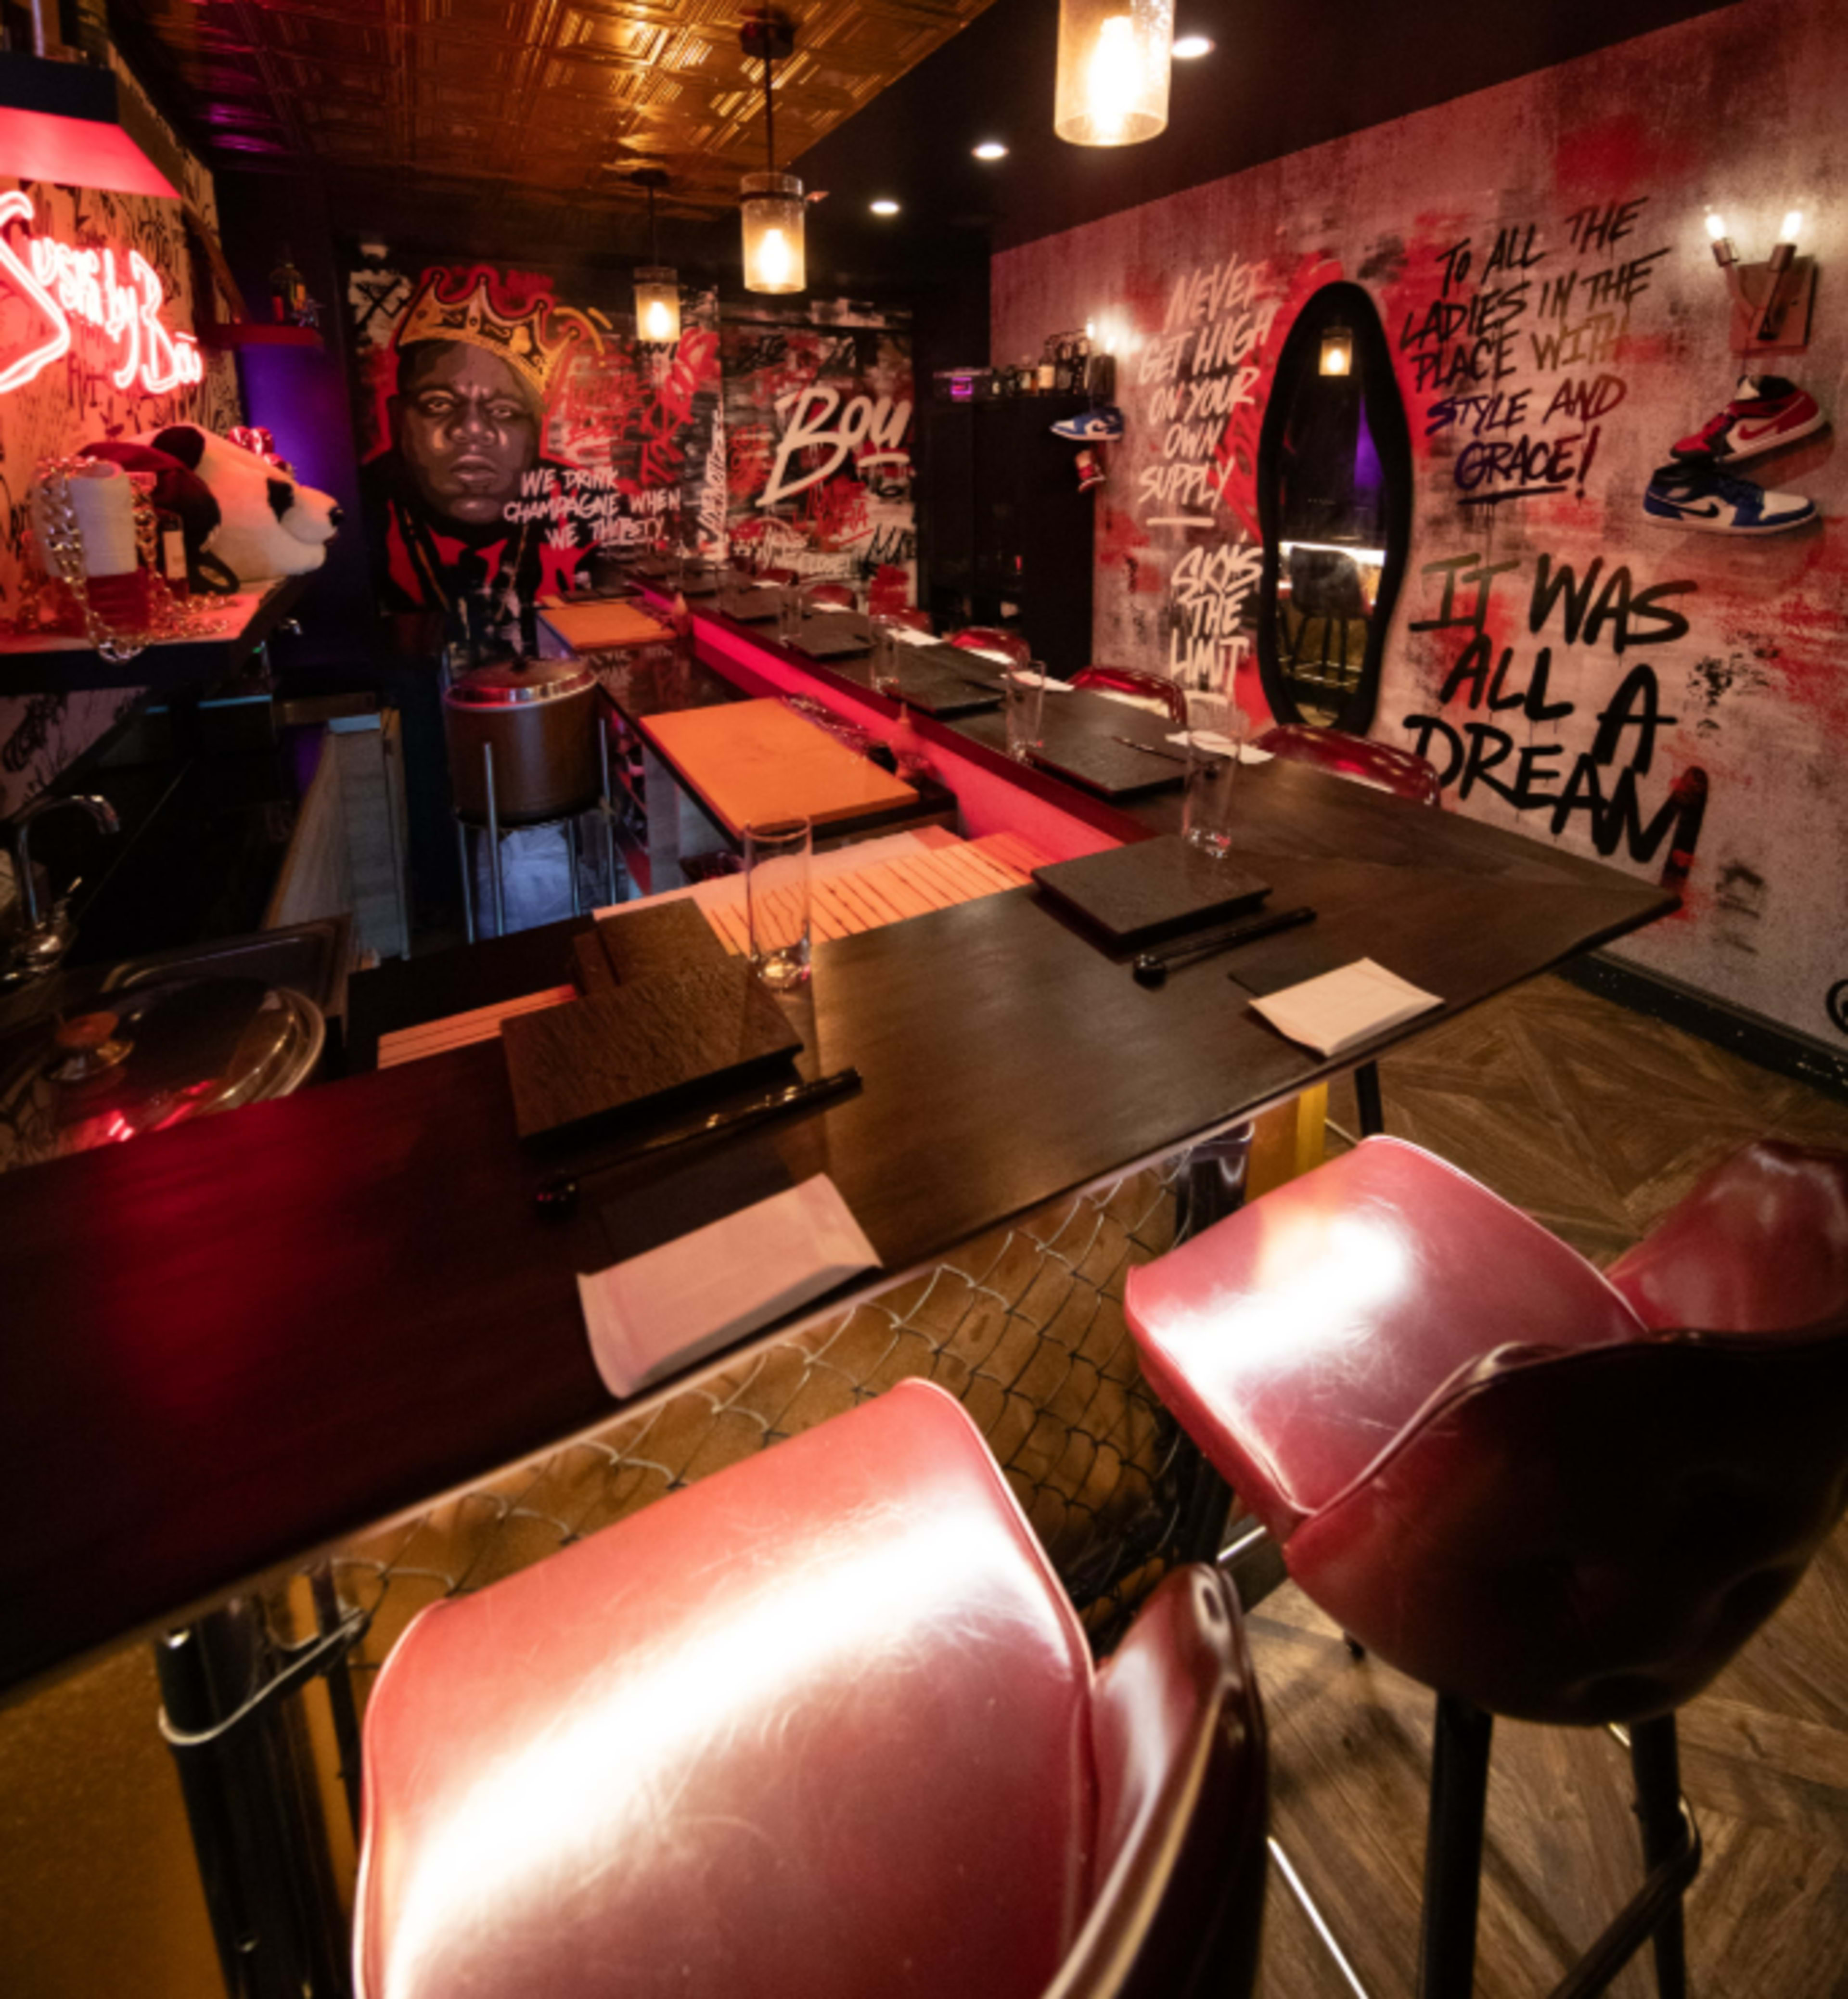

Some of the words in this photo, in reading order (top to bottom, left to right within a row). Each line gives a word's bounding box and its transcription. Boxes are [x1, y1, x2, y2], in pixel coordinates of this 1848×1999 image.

[1436, 238, 1471, 297] TO
[1480, 224, 1548, 284] ALL
[1565, 196, 1649, 254] THE
[1162, 252, 1275, 335] NEVER
[1400, 281, 1532, 349] LADIES
[1538, 271, 1578, 319] IN
[1581, 247, 1671, 308] THE
[1139, 332, 1194, 384] GET
[1192, 301, 1282, 375] HIGH
[1411, 329, 1520, 393] PLACE
[1530, 312, 1630, 371] WITH
[1149, 382, 1185, 426] ON
[1184, 367, 1260, 423] YOUR
[1424, 388, 1533, 436] STYLE
[1542, 373, 1628, 425] AND
[1165, 420, 1225, 459] OWN
[1455, 425, 1601, 499] GRACE!
[504, 493, 619, 523] CHAMPAGNE
[629, 488, 680, 514] WHEN
[521, 468, 556, 497] WE
[561, 466, 618, 490] DRINK
[1138, 456, 1235, 511] SUPPLY
[545, 524, 579, 550] WE
[1186, 588, 1250, 637] THE
[1408, 552, 1521, 635] IT
[1529, 552, 1697, 654] WAS
[1170, 628, 1249, 698] LIMIT
[1440, 633, 1575, 721] ALL
[1592, 664, 1678, 776] A
[1402, 714, 1708, 890] DREAM
